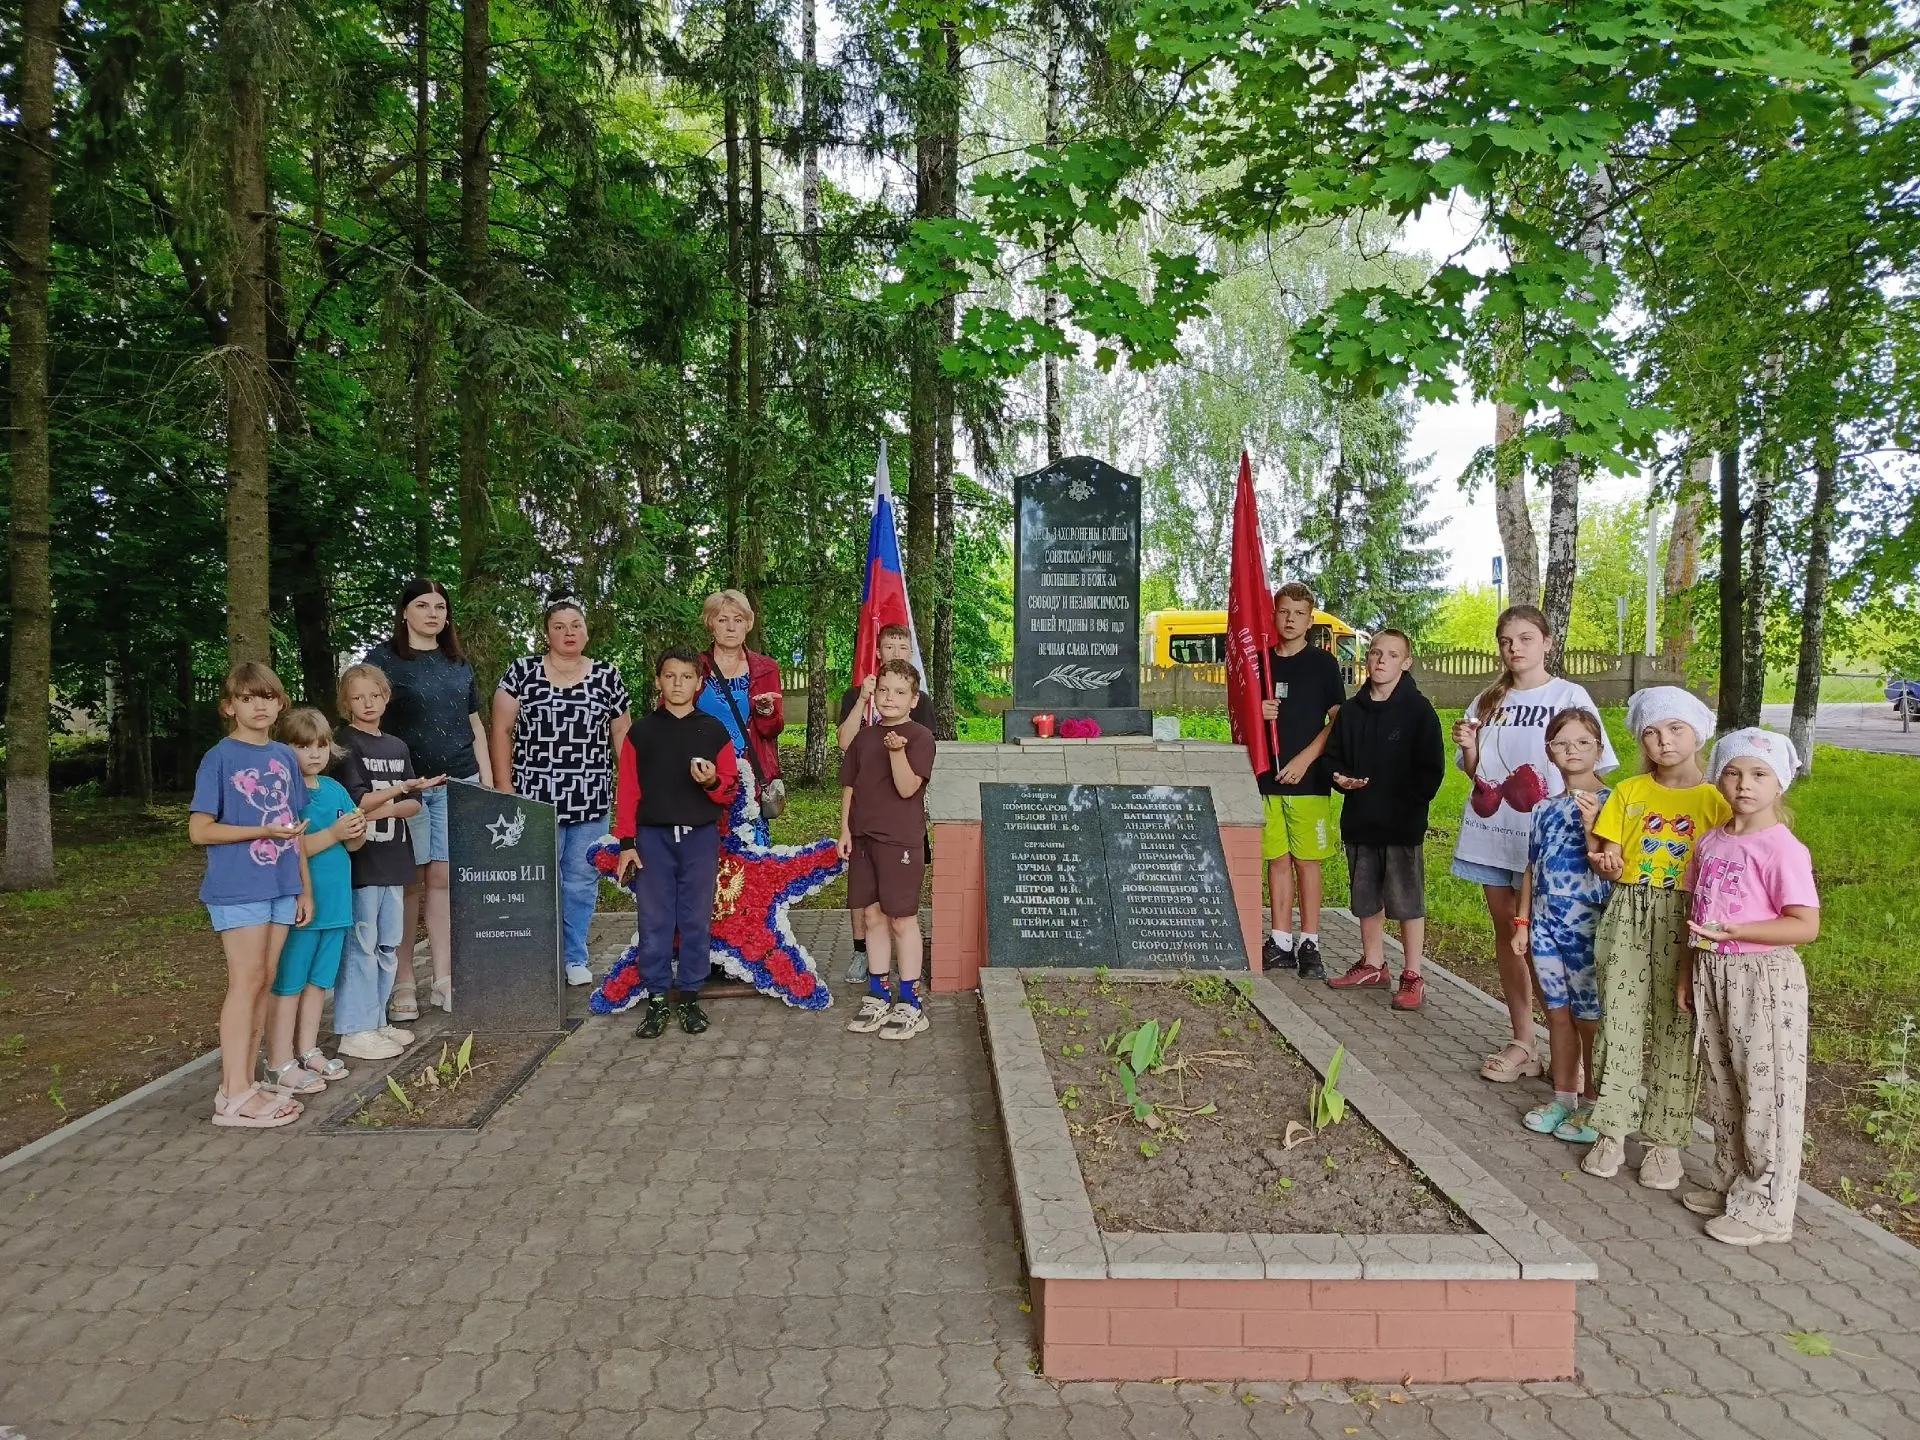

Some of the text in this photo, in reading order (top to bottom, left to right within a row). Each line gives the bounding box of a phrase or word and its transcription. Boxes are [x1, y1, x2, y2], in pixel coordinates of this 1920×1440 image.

[1053, 527, 1100, 541] ЗАХОРОНЕНЫ
[1045, 546, 1112, 564] СОВЕТСКОЙ АРМИИ
[1041, 573, 1117, 587] ПОГИБШИЕ В БОЯХ ЗА
[1028, 595, 1130, 611] СВОБОДУ И НЕЗАВИСИМОСТЬ
[1031, 614, 1057, 632] НАШЕЙ
[1058, 618, 1088, 634] РОДИНЫ
[1089, 618, 1095, 632] В
[1038, 642, 1119, 656] ВЕЧНАЯ СЛАВА ГЕРОЯМ
[1020, 792, 1057, 800] ОФИЦЕРЫ
[1002, 803, 1068, 812] КОМИССАРОВ
[1014, 813, 1047, 821] БЕЛОВ
[1004, 822, 1057, 831] ДУБИЦКИЙ
[1125, 822, 1171, 830] АНДРЕЕВ
[1491, 824, 1514, 838] cherry
[1024, 841, 1065, 849] СЕРЖАНТЫ
[1010, 852, 1057, 861] БАРАНОВ
[1138, 852, 1196, 860] ИБРАИМОВ
[1016, 863, 1052, 872] КУЧМА
[458, 865, 545, 882] Збиняков И.П
[1018, 874, 1053, 882] НОСОВ
[1133, 874, 1182, 882] ЛОЖКИН
[1015, 885, 1055, 893] ПЕТРОВ
[482, 893, 500, 904] 1904
[508, 893, 525, 903] 1941
[1003, 896, 1070, 905] РАЗЛИВАНОВ
[1127, 895, 1193, 904] ПЕРЕВЕРЗЕВ
[1021, 907, 1053, 915] СЕНТА
[1130, 906, 1197, 915] ПЛОТНИКОВ
[1012, 917, 1065, 927] ШТЕЙМАН
[475, 927, 532, 939] неизвестный
[1021, 929, 1059, 938] ШАЛАН
[1140, 929, 1195, 938] СМИРНОВ
[1131, 941, 1208, 951] СКОРОДУМОВ
[1148, 953, 1196, 962] ОСИПОВ
